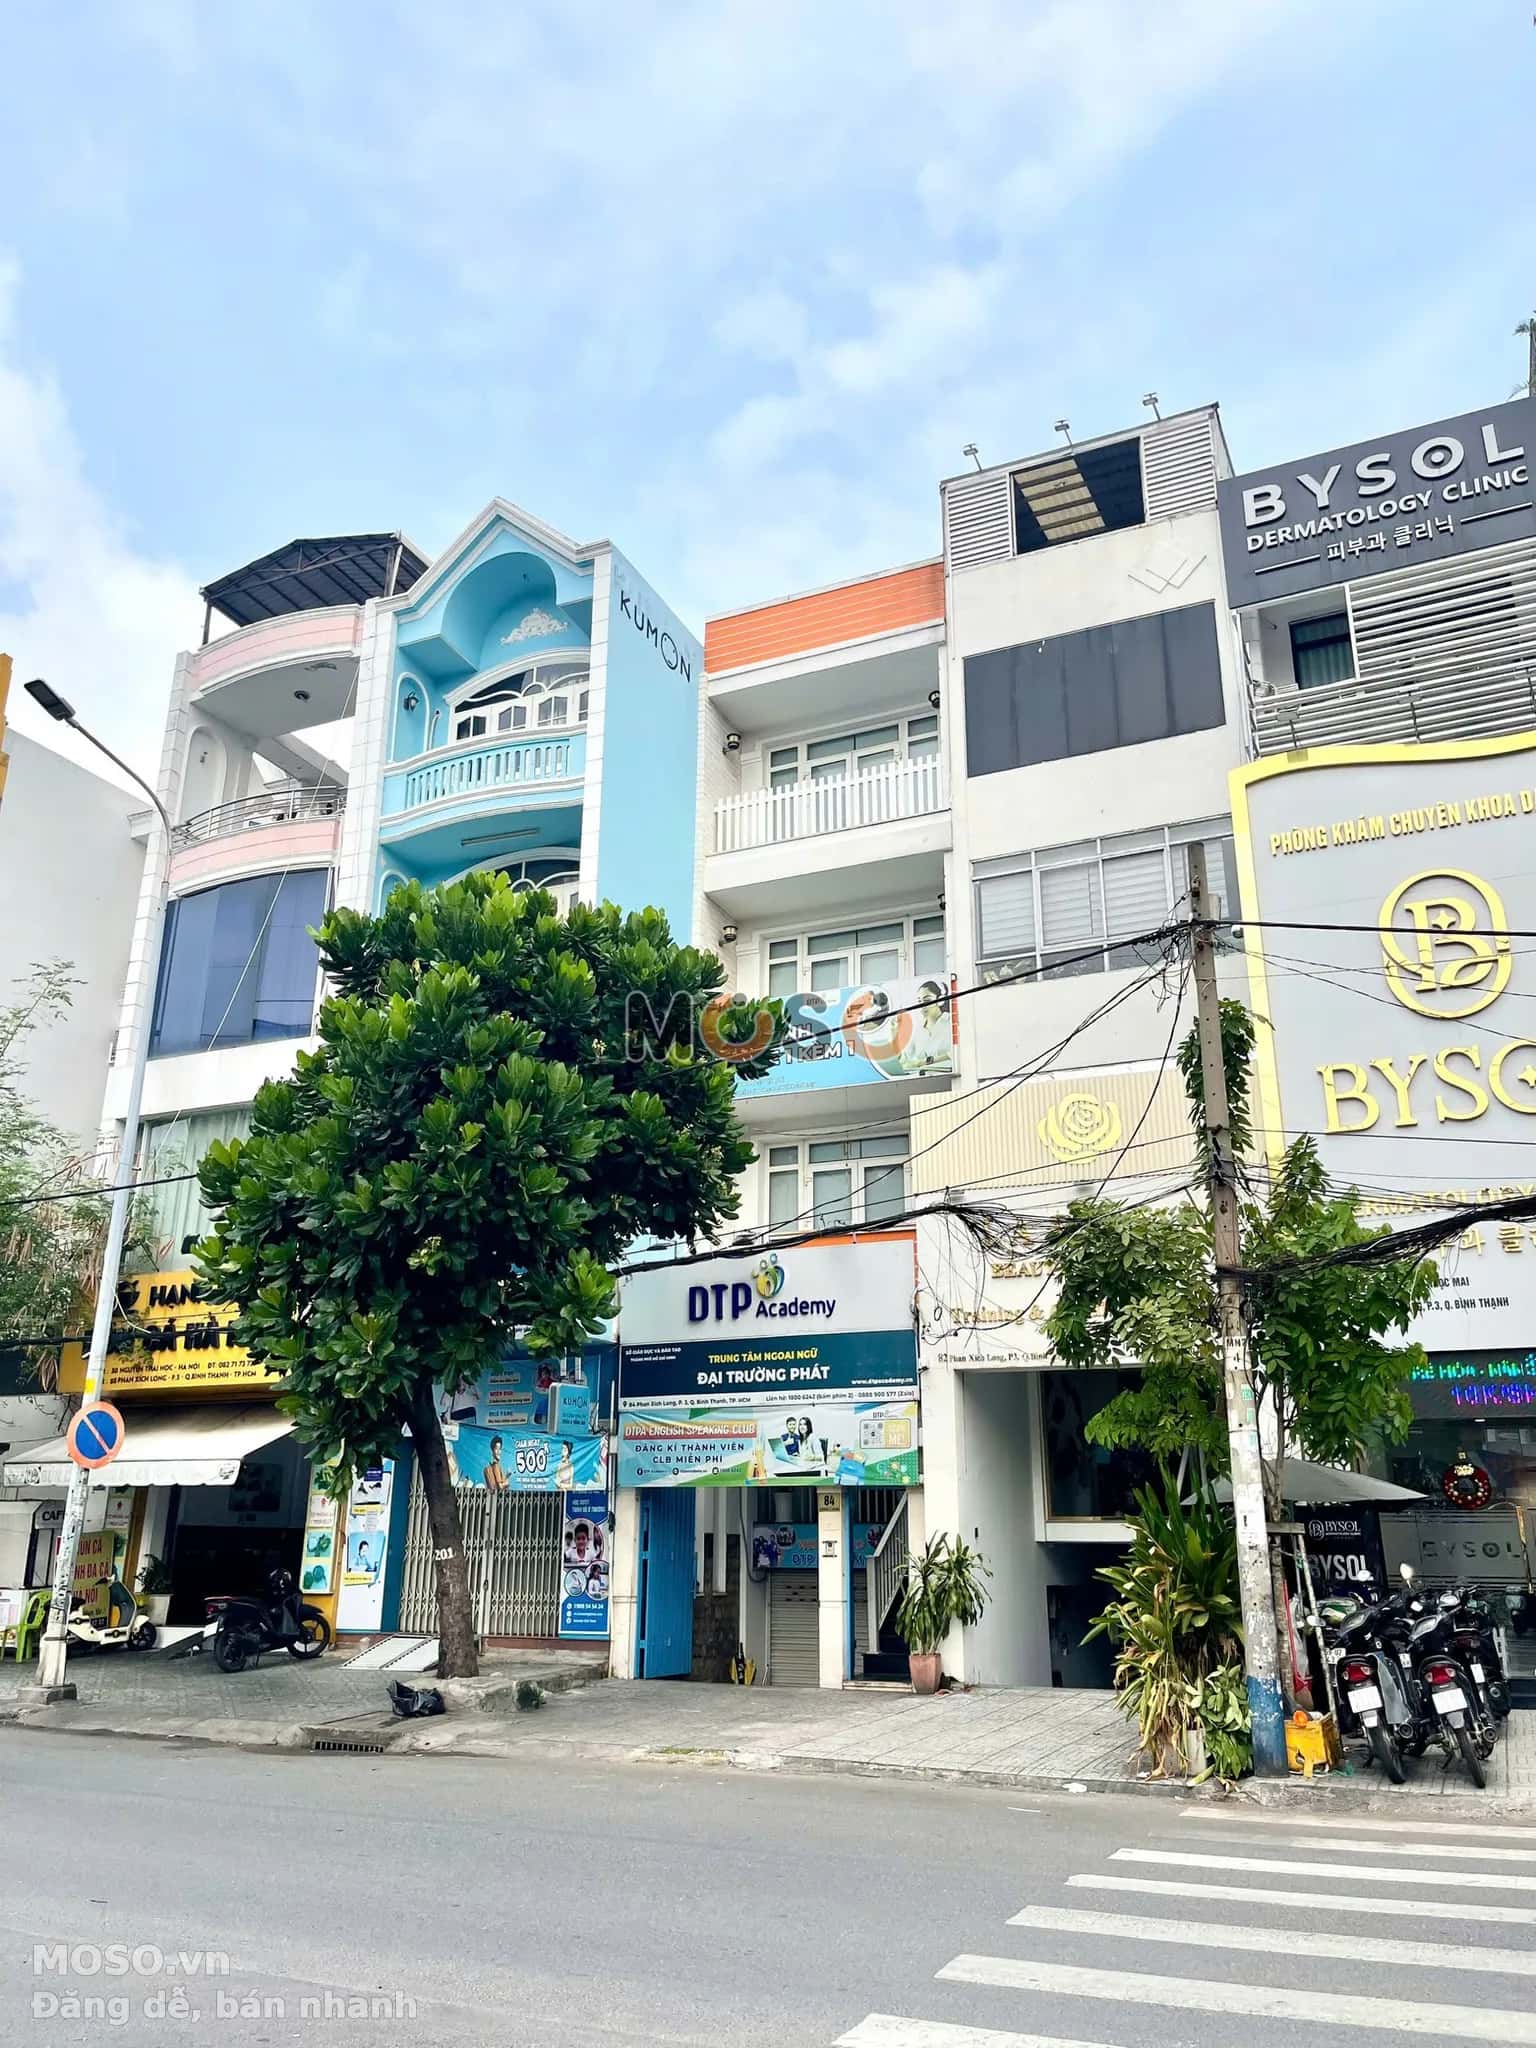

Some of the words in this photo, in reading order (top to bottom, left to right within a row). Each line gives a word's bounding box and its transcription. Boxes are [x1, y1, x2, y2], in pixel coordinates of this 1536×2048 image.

[1242, 424, 1524, 528] BYSOL
[1247, 491, 1432, 552] DERMATOLOGY
[1442, 465, 1529, 501] CLINIC
[1327, 531, 1387, 561] 피부과
[1393, 514, 1455, 546] 클리닉
[620, 589, 691, 683] KUMON
[1269, 826, 1329, 855] PHÒNG
[1331, 815, 1386, 846] KHÁM
[1389, 801, 1462, 836] CHUYÊN
[1466, 793, 1517, 823] KHOA
[1520, 788, 1536, 813] D
[1452, 1277, 1470, 1287] MAI
[688, 1282, 752, 1322] DTP
[755, 1297, 836, 1318] Academy
[1455, 1297, 1477, 1309] BÌNH
[1479, 1296, 1510, 1310] THẠNH
[708, 1353, 740, 1364] TRUNG
[741, 1351, 762, 1363] TÂM
[764, 1349, 795, 1362] NGOẠI
[796, 1347, 818, 1360] NGỮ
[697, 1372, 723, 1388] ĐẠI
[725, 1366, 787, 1384] TRƯỜNG
[790, 1363, 830, 1381] PHÁT
[686, 1424, 730, 1435] SPEAKING
[733, 1423, 755, 1434] CLUB
[652, 1455, 672, 1464] CLB
[823, 1495, 835, 1506] 84
[1325, 1520, 1361, 1532] BYSOL
[434, 1547, 455, 1561] 201
